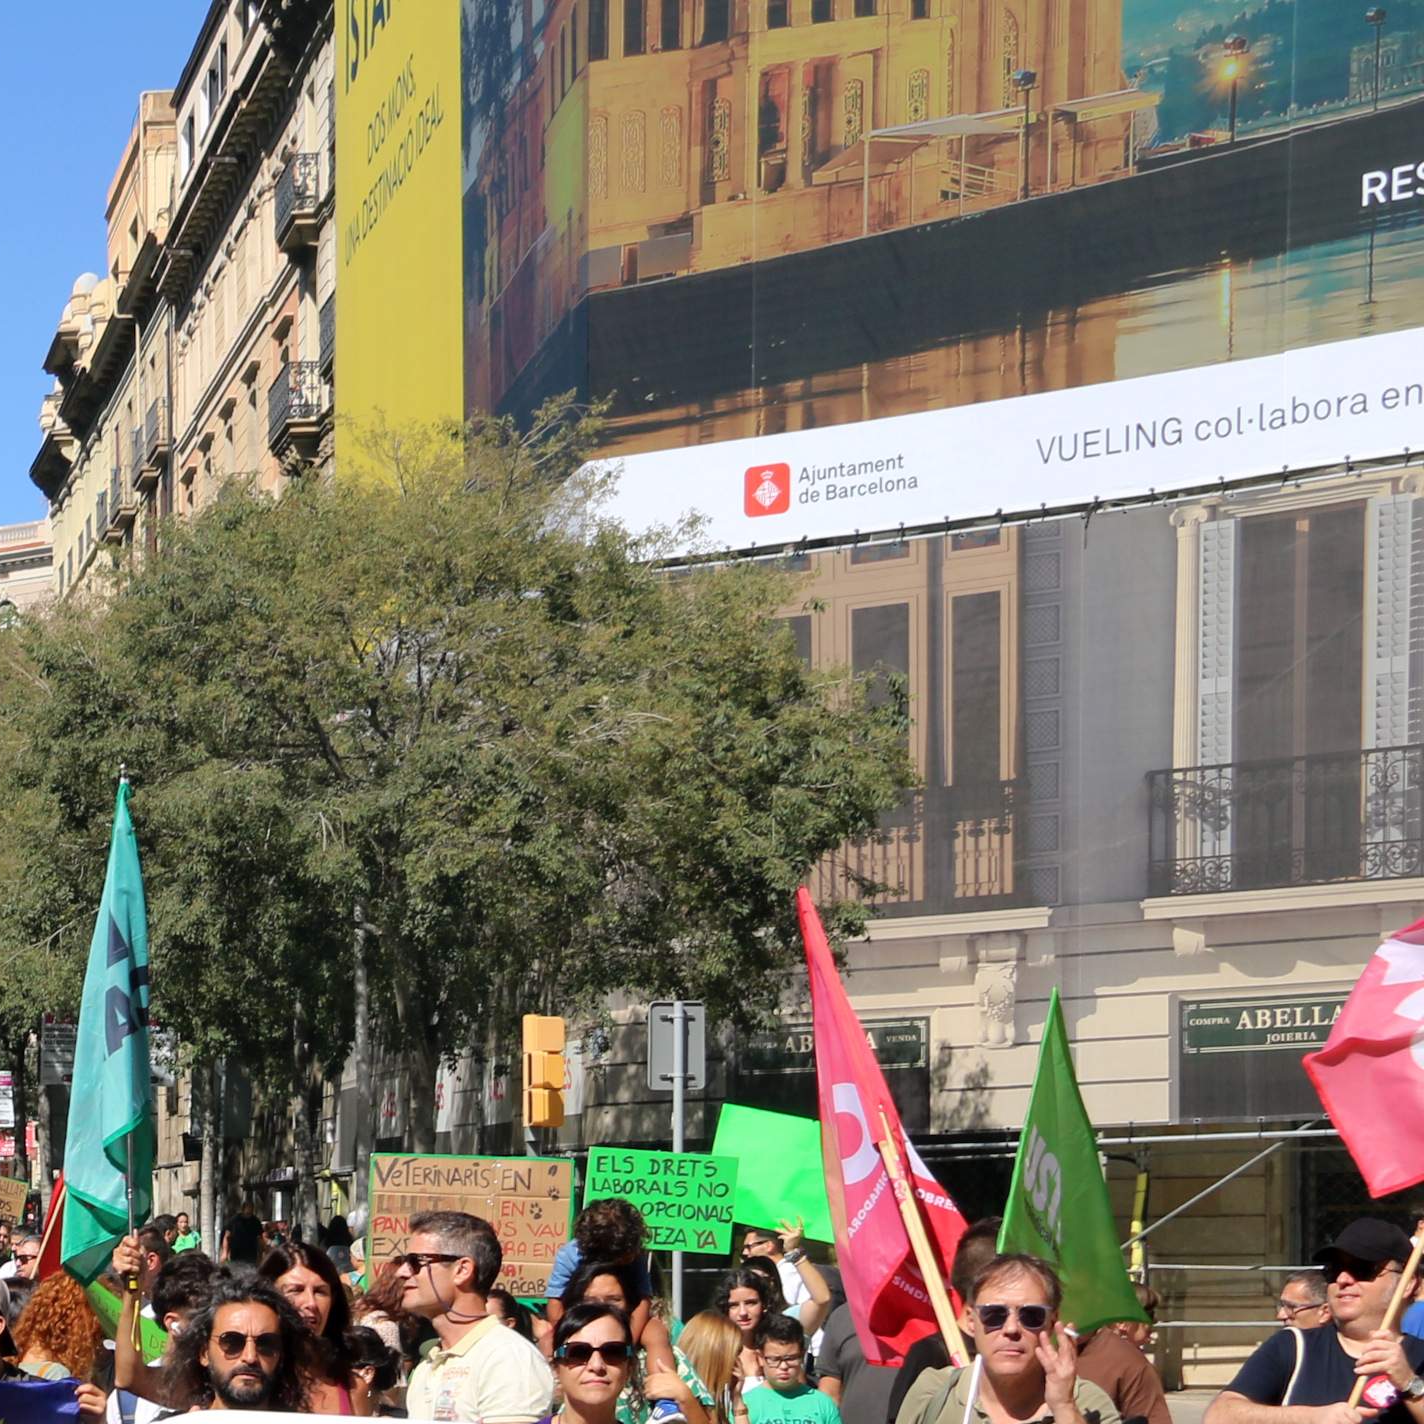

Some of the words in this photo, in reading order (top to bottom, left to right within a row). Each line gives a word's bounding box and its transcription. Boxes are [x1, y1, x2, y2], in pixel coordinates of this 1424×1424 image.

[367, 101, 386, 165] DOS
[344, 211, 361, 267] UNA
[361, 116, 414, 241] DESTINACIÓ
[415, 82, 445, 160] IDEAL
[1035, 416, 1185, 466] VUELING
[1193, 384, 1369, 443] col·labora
[1379, 383, 1424, 412] en
[798, 454, 905, 485] Ajuntament
[798, 485, 821, 505] de
[824, 473, 919, 502] Barcelona
[1188, 1016, 1232, 1027] COMPRA
[886, 1034, 918, 1043] VENDA
[1265, 1031, 1318, 1045] JOIERIA
[596, 1155, 635, 1175] ELS
[647, 1158, 718, 1178] DRETS
[501, 1167, 532, 1193] EN
[592, 1177, 689, 1198] LABORALS
[697, 1181, 730, 1199] NO
[502, 1200, 525, 1217] EN
[639, 1201, 734, 1224] OPCIONALS
[526, 1223, 565, 1238] VAU
[692, 1228, 718, 1249] YA
